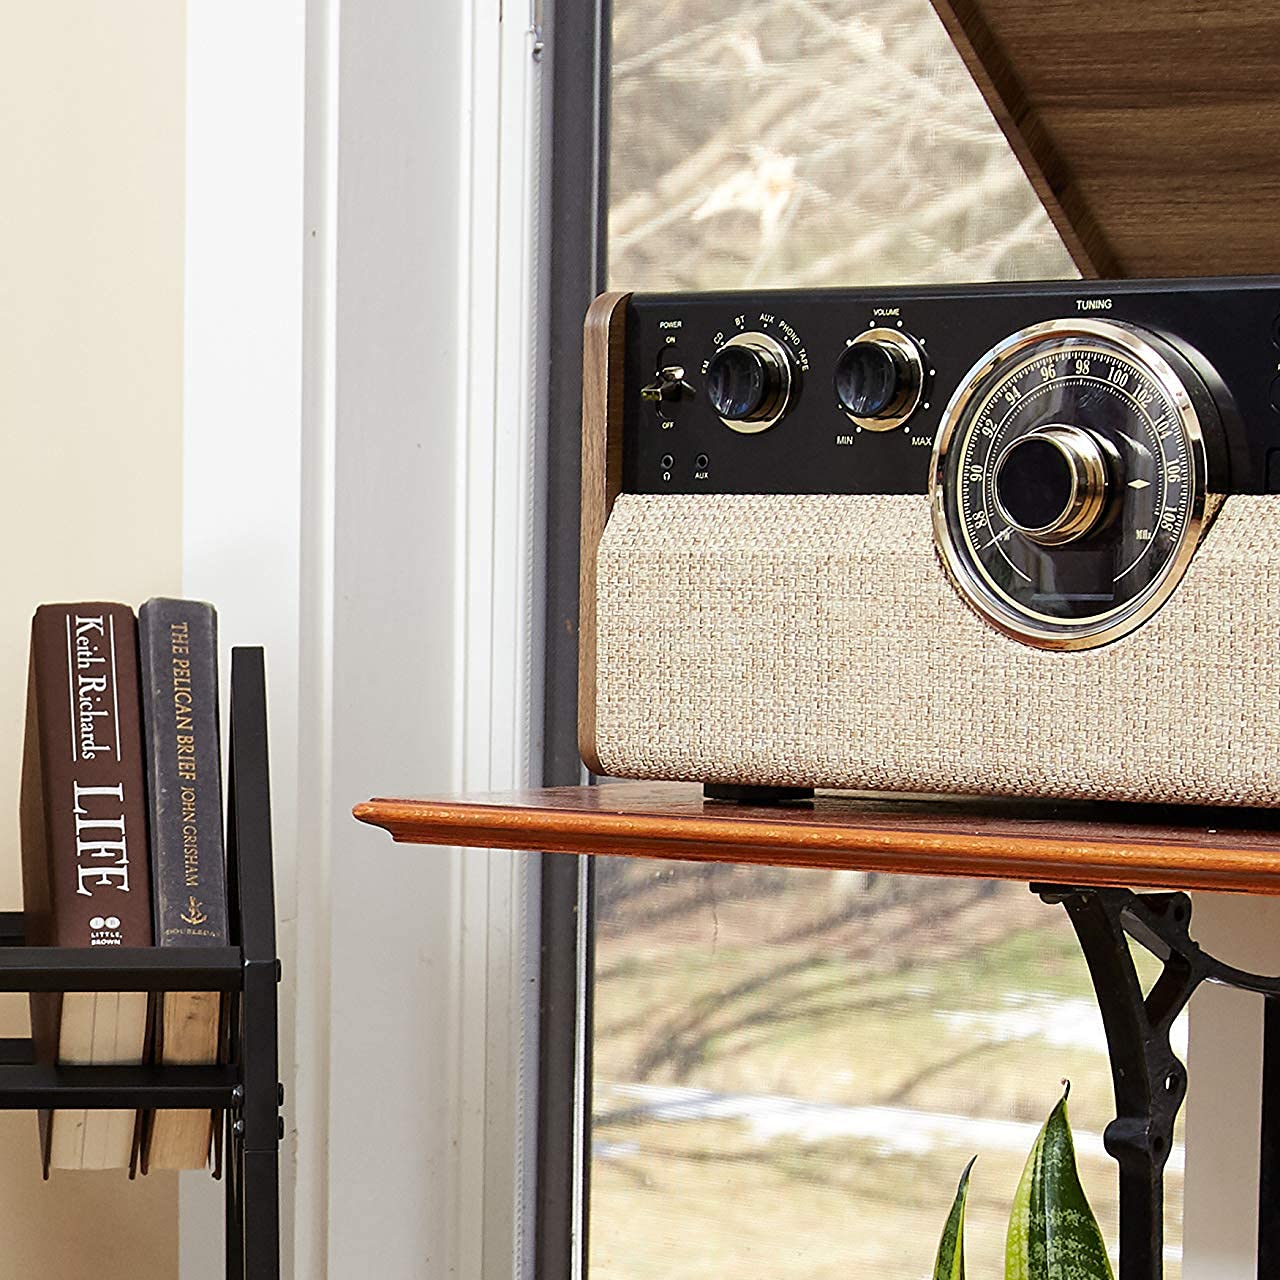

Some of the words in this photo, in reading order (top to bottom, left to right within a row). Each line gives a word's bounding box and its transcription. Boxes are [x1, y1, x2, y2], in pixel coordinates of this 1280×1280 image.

[873, 308, 900, 317] VOLUME
[1076, 299, 1112, 310] TUNING
[659, 321, 682, 329] POWER
[735, 314, 745, 326] BT
[759, 312, 775, 324] AUX
[665, 336, 676, 344] ON
[713, 332, 723, 345] CD
[779, 320, 800, 346] PHONO
[798, 349, 811, 372] TAPE
[1075, 359, 1090, 374] 98
[1040, 364, 1056, 381] 96
[1107, 366, 1129, 388] 100
[1004, 386, 1022, 405] 94
[1132, 384, 1154, 407] 102
[662, 421, 674, 429] OFF
[982, 419, 998, 439] 92
[1154, 415, 1173, 441] 104
[836, 436, 853, 445] MIN
[911, 437, 932, 446] MAX
[695, 472, 709, 480] AUX
[970, 465, 983, 483] 90
[1167, 458, 1181, 483] 106
[972, 511, 987, 529] 88
[1160, 506, 1178, 532] 108
[74, 615, 105, 670] Keith
[170, 623, 189, 655] THE
[172, 659, 195, 730] PELICAN
[77, 675, 111, 761] Richards
[173, 733, 197, 780] BRIEF
[180, 787, 196, 821] JOHN
[72, 780, 131, 897] LIFE
[181, 821, 199, 888] GRISHAM
[90, 931, 123, 939] LITTLE,
[91, 938, 121, 946] BROWN
